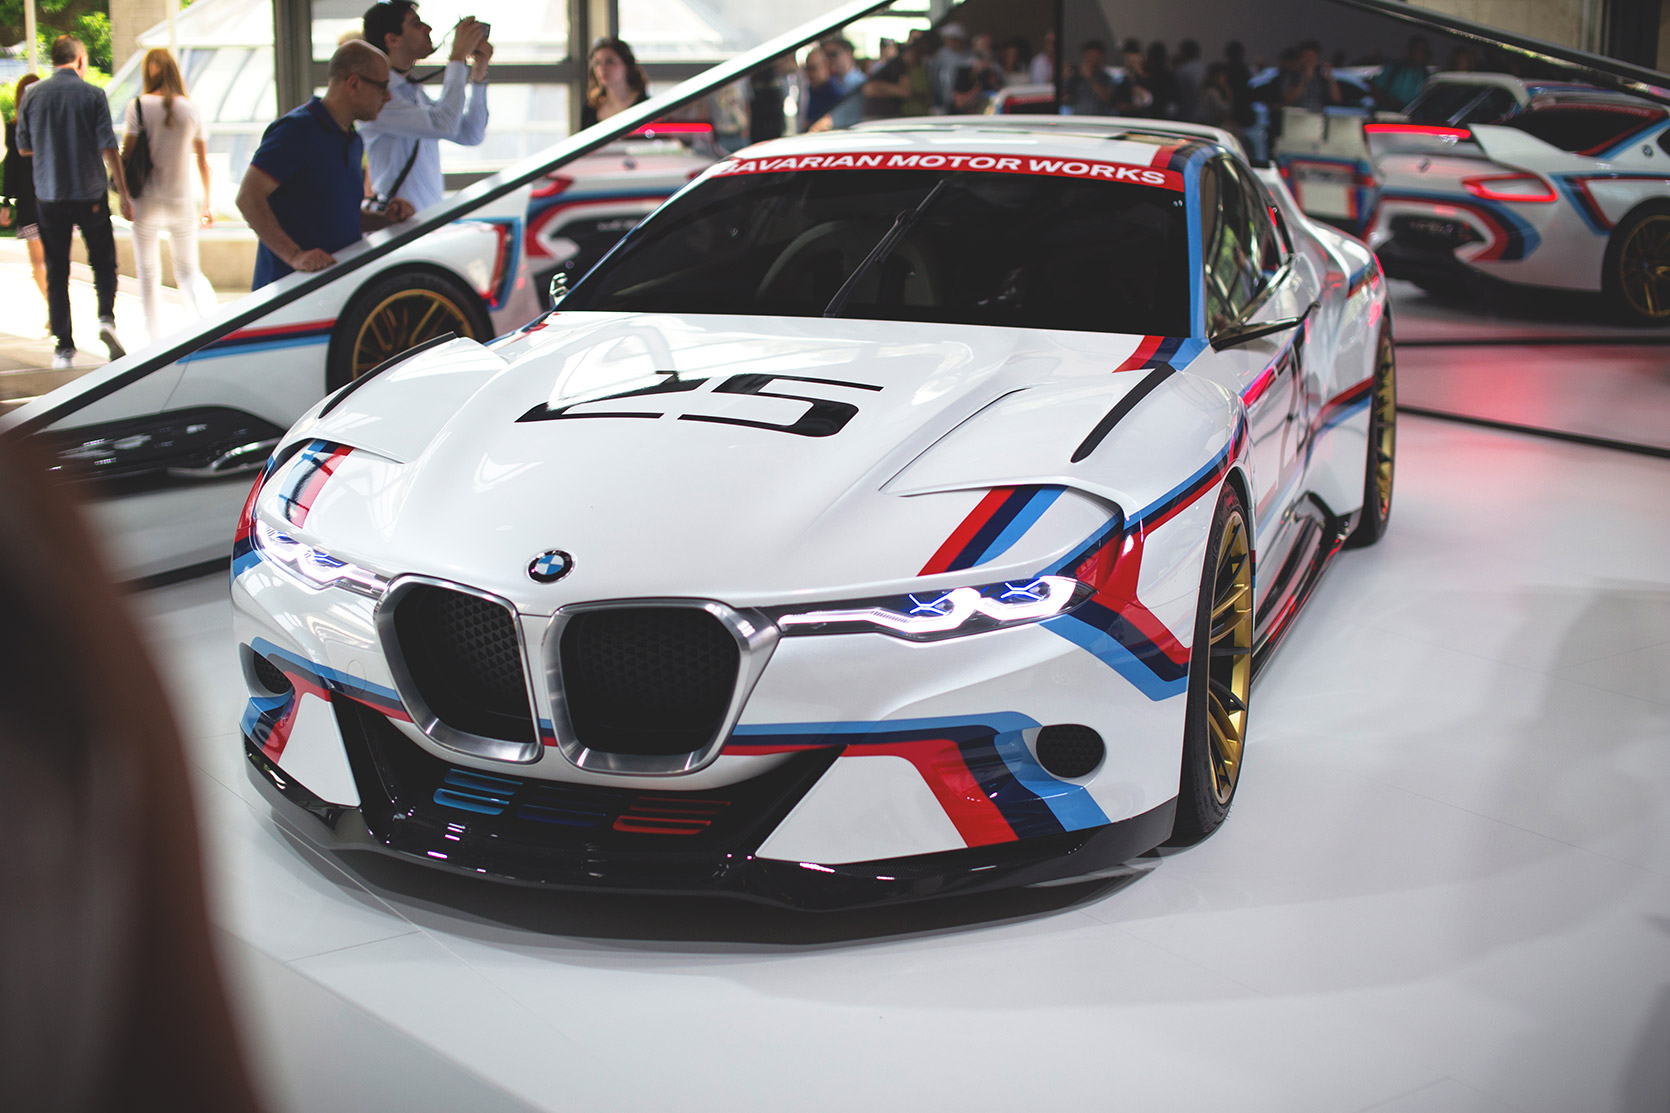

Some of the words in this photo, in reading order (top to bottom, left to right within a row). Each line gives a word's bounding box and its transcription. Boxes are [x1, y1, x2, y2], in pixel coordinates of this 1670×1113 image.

[887, 155, 1022, 170] MOTOR
[1029, 159, 1165, 184] WORKS
[514, 370, 884, 437] 25
